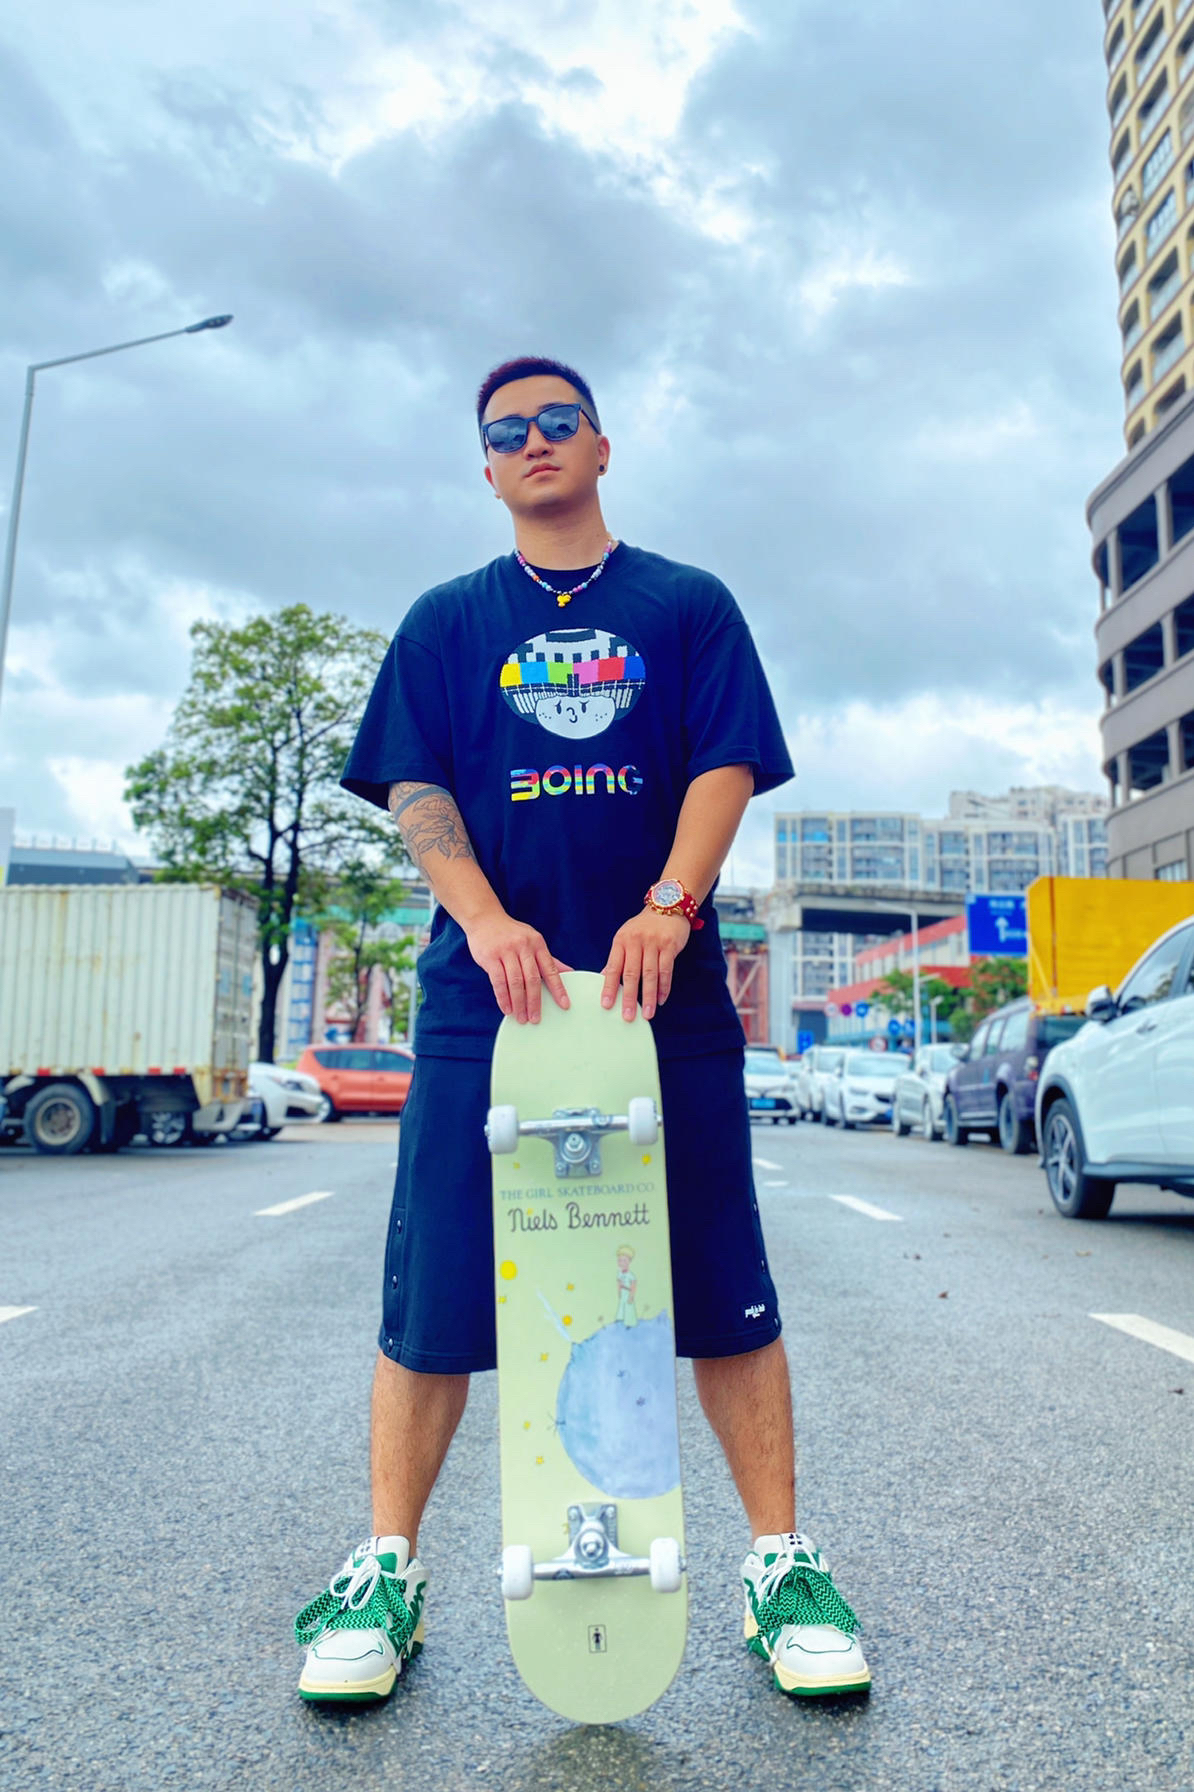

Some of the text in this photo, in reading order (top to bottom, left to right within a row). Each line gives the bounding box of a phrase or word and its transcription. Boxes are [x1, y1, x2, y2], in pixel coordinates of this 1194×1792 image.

[500, 1189, 523, 1200] THE
[525, 1187, 553, 1199] GIRL
[557, 1183, 634, 1198] SKATEBOARD
[507, 1201, 650, 1232] Niels Bennett
